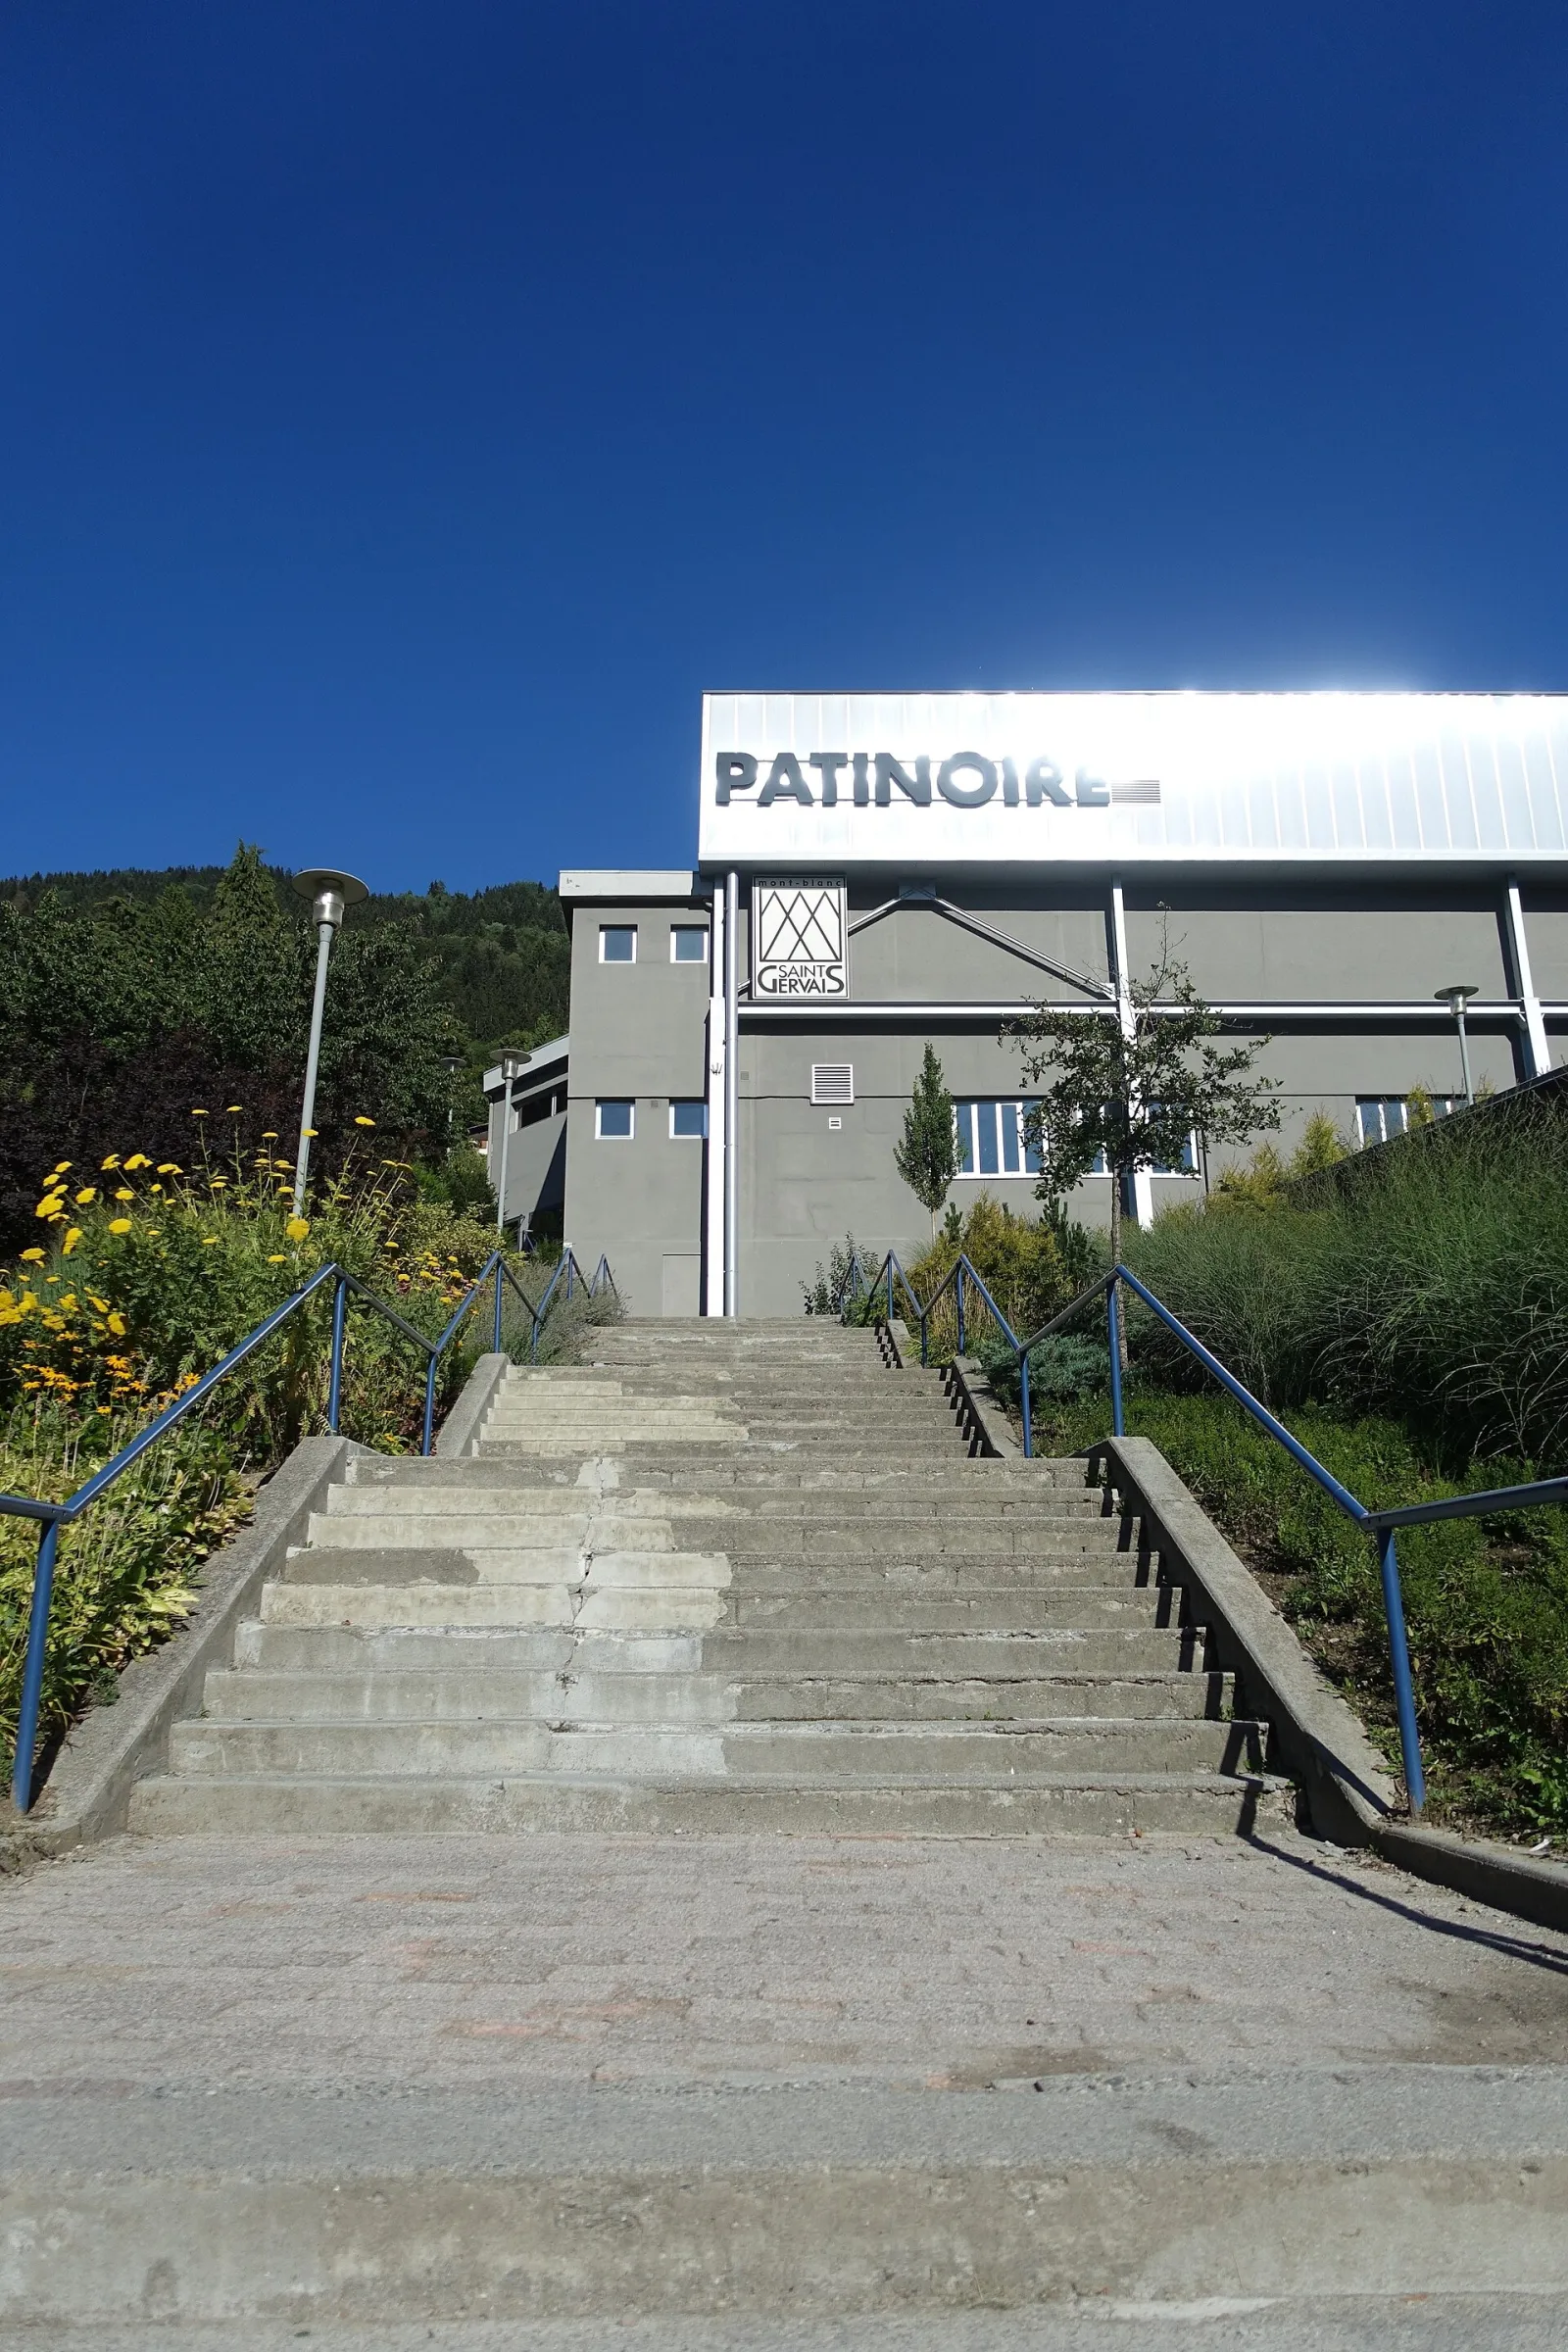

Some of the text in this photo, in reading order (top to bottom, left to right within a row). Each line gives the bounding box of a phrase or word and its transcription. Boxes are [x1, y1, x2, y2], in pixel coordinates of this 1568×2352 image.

[715, 752, 1111, 808] PATINOIRE
[758, 879, 842, 888] mont-blanc
[778, 964, 826, 978] SAINT
